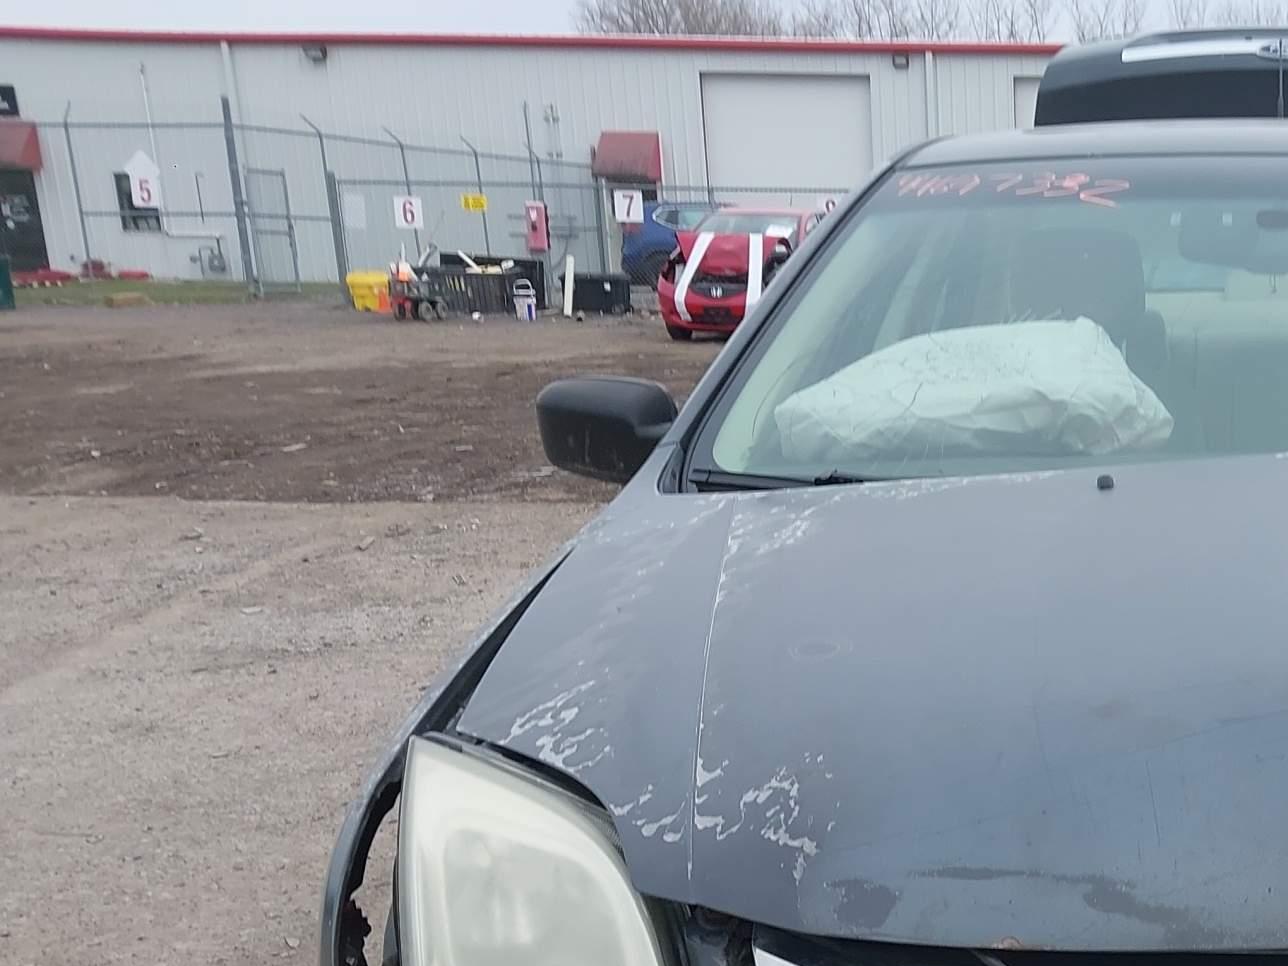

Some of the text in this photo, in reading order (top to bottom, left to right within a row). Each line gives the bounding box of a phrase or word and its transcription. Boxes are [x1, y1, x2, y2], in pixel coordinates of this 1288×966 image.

[138, 179, 152, 204] 5
[402, 199, 416, 225] 6
[622, 192, 634, 218] 7
